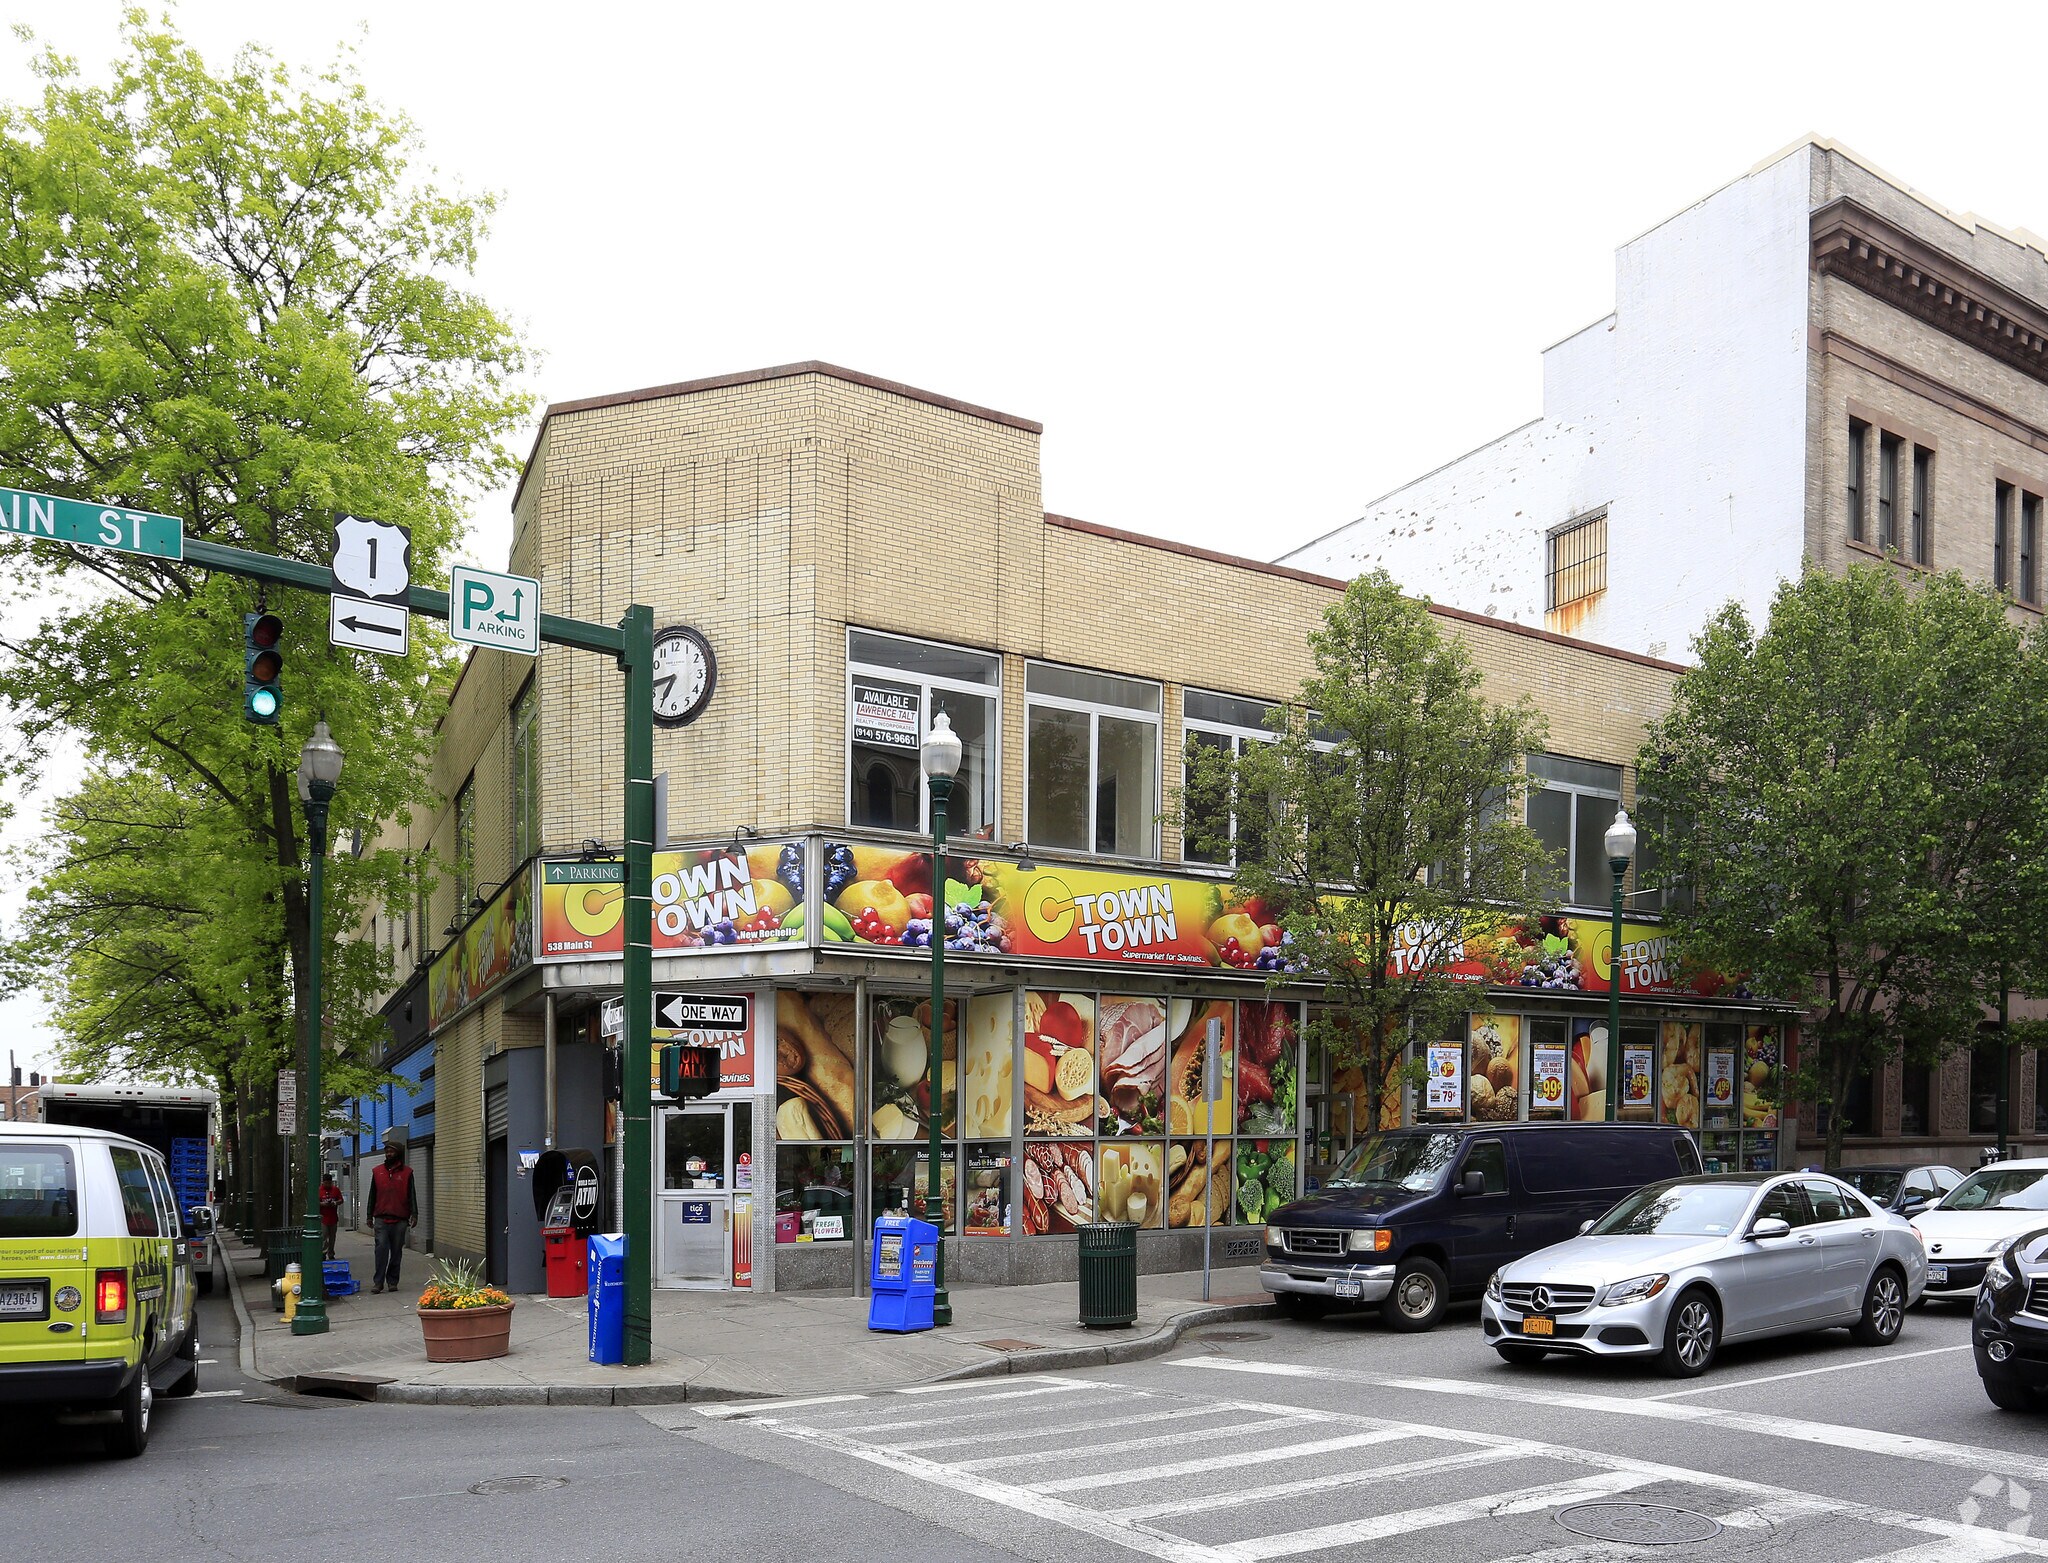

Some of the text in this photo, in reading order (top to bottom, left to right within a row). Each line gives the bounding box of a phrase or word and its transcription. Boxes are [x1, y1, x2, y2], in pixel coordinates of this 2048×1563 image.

[98, 509, 148, 549] ST
[366, 537, 378, 580] 1
[462, 579, 526, 640] PARKING
[659, 648, 667, 658] 11
[671, 641, 681, 652] 12
[685, 644, 689, 654] 1
[653, 660, 660, 670] 0
[693, 653, 700, 663] 2
[696, 669, 703, 679] 3
[691, 683, 699, 694] 4
[684, 696, 690, 707] 5
[862, 690, 909, 709] AVAILABLE
[670, 702, 678, 712] 6
[856, 703, 916, 721] LAWRENCE TALT
[855, 717, 915, 732] REALTY INCORPORATED
[855, 727, 915, 745] (914) 576-9661
[569, 866, 619, 879] PARKING
[651, 854, 751, 906] OWN
[651, 884, 758, 936] OWN
[1024, 875, 1174, 943] C TOWN
[739, 927, 797, 939] New Rochelle
[1078, 912, 1178, 955] TOWN
[547, 940, 593, 951] 538 Main St
[1121, 950, 1165, 961] Supermarket
[1166, 952, 1176, 961] for
[681, 1005, 738, 1020] ONE WAY
[1543, 1079, 1563, 1098] 99¢
[917, 1150, 954, 1159] Boar Head
[575, 1186, 597, 1206] ATM
